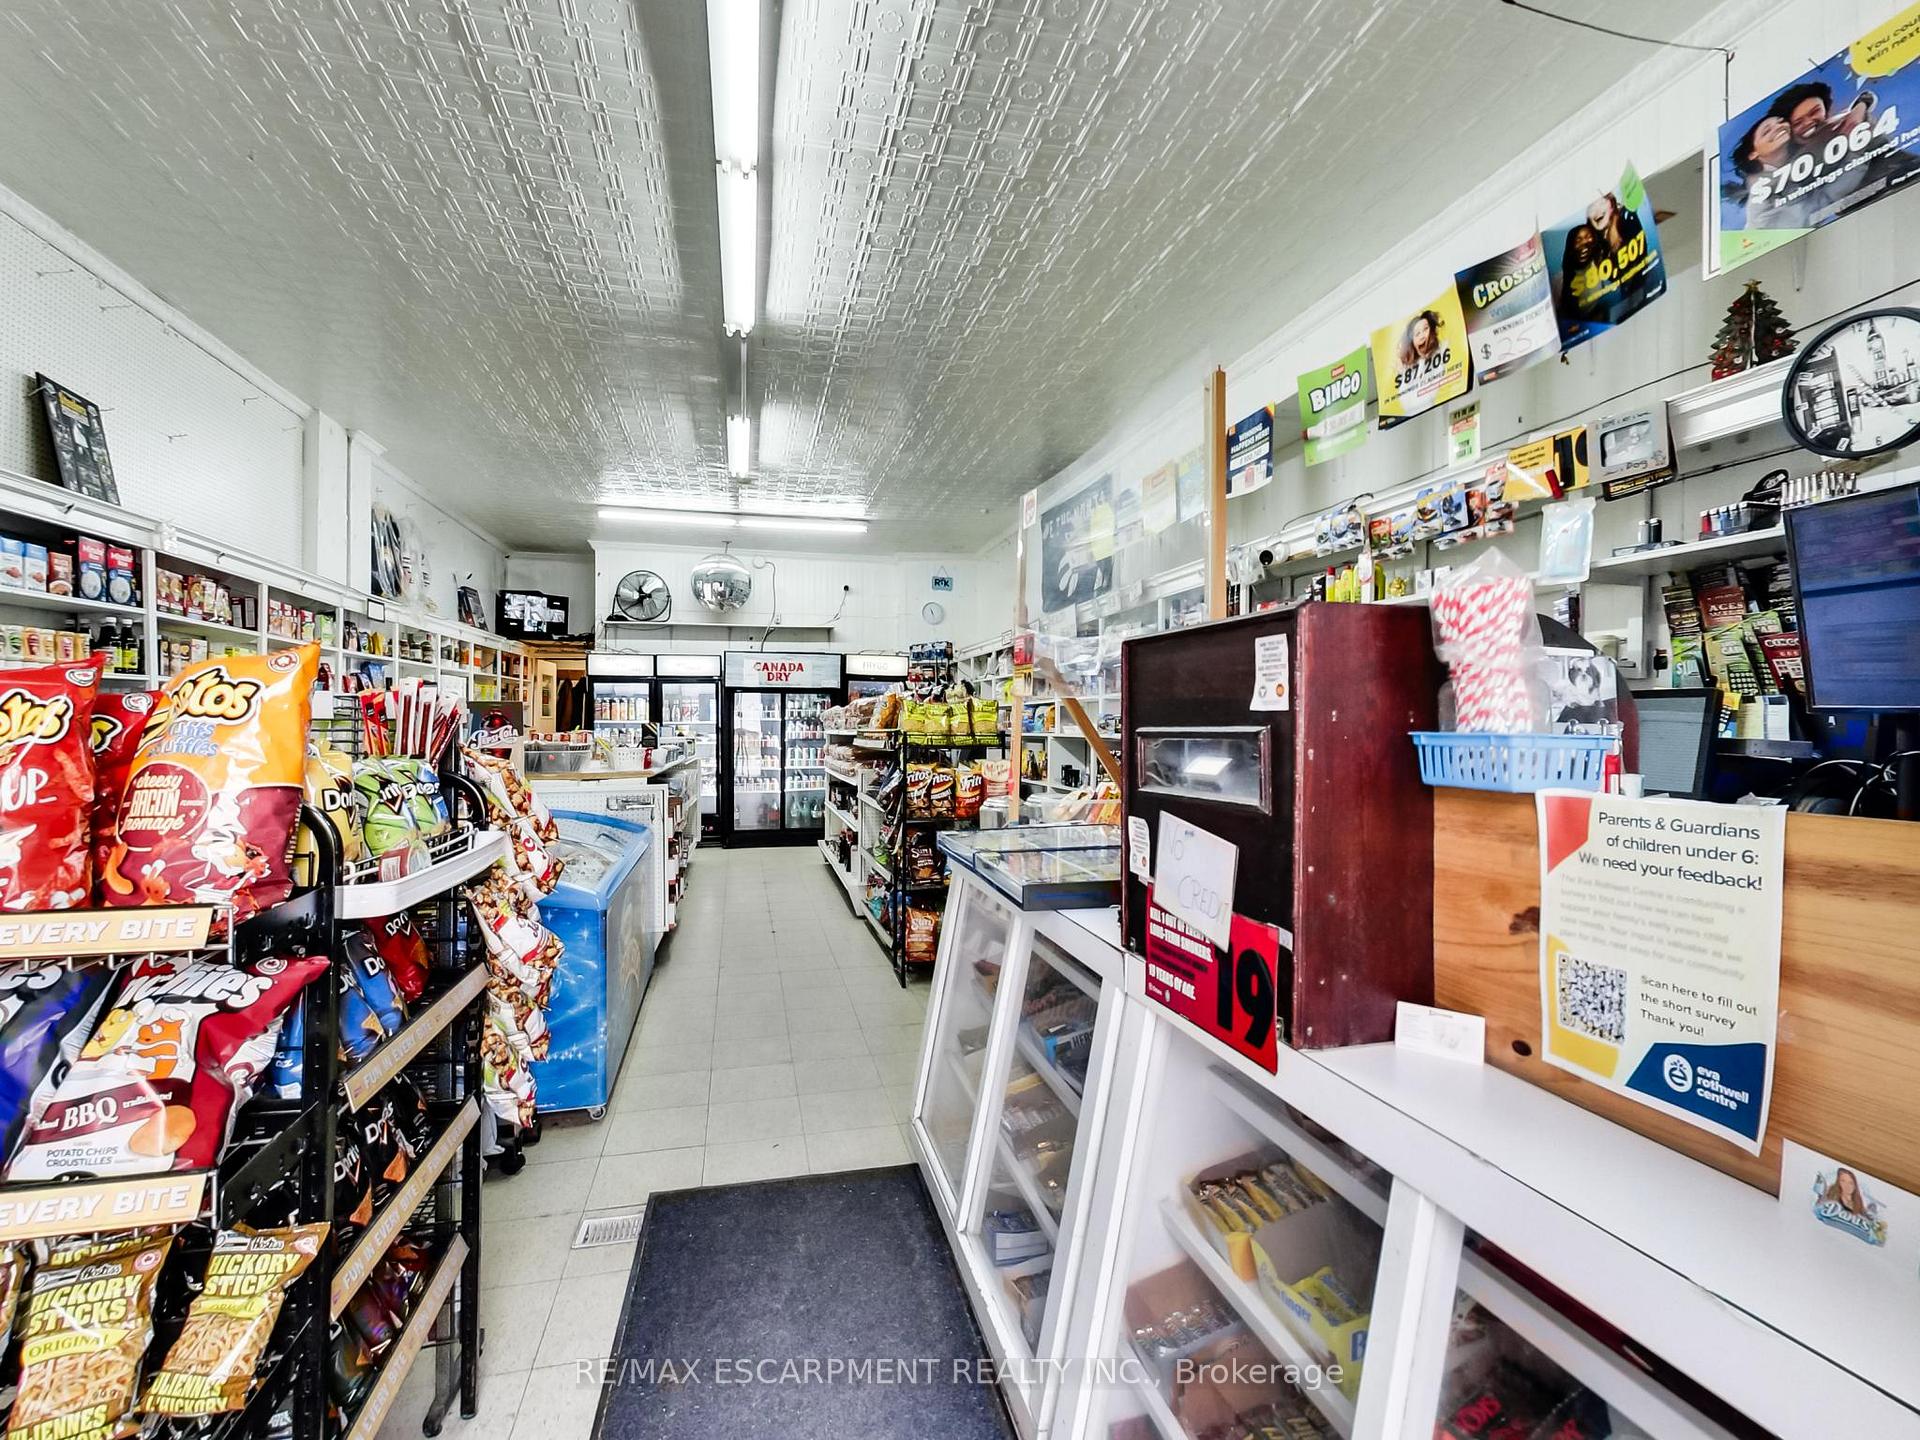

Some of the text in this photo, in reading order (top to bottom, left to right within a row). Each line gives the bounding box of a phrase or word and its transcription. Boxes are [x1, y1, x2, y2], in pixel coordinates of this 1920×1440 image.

[1750, 105, 1900, 204] $70,064
[1787, 166, 1844, 203] winnings
[1844, 136, 1899, 172] claimed
[1571, 231, 1645, 297] $80,507
[1395, 348, 1452, 390] $87,206
[1308, 370, 1361, 413] BINGO
[753, 661, 804, 672] CANADA
[767, 672, 791, 682] DRY
[130, 789, 181, 816] BACON
[1599, 811, 1761, 840] Parents & Guardians
[1606, 834, 1760, 866] of children under 6:
[1578, 851, 1763, 891] We need your feedback!
[0, 916, 198, 945] EVERY BITE
[1210, 938, 1275, 1050] 19
[1641, 975, 1758, 1016] Scan here to fill out
[1640, 993, 1737, 1030] the short survey
[1640, 1009, 1704, 1037] Thank you!
[1696, 1066, 1720, 1081] eva
[1696, 1076, 1750, 1104] rothwell
[62, 1096, 119, 1131] BBQ
[1696, 1088, 1738, 1111] centre
[46, 1157, 113, 1168] CROUSTILLES
[47, 1146, 118, 1158] POTATO CHIPS
[0, 1185, 192, 1227] EVERY BITE
[212, 1254, 302, 1276] HICKORY
[342, 1261, 365, 1290] FUN
[374, 1210, 401, 1244] EVERY
[31, 1274, 144, 1315] HICKORY
[28, 1298, 128, 1337] STICKS
[29, 1334, 110, 1358] ORIGINAL
